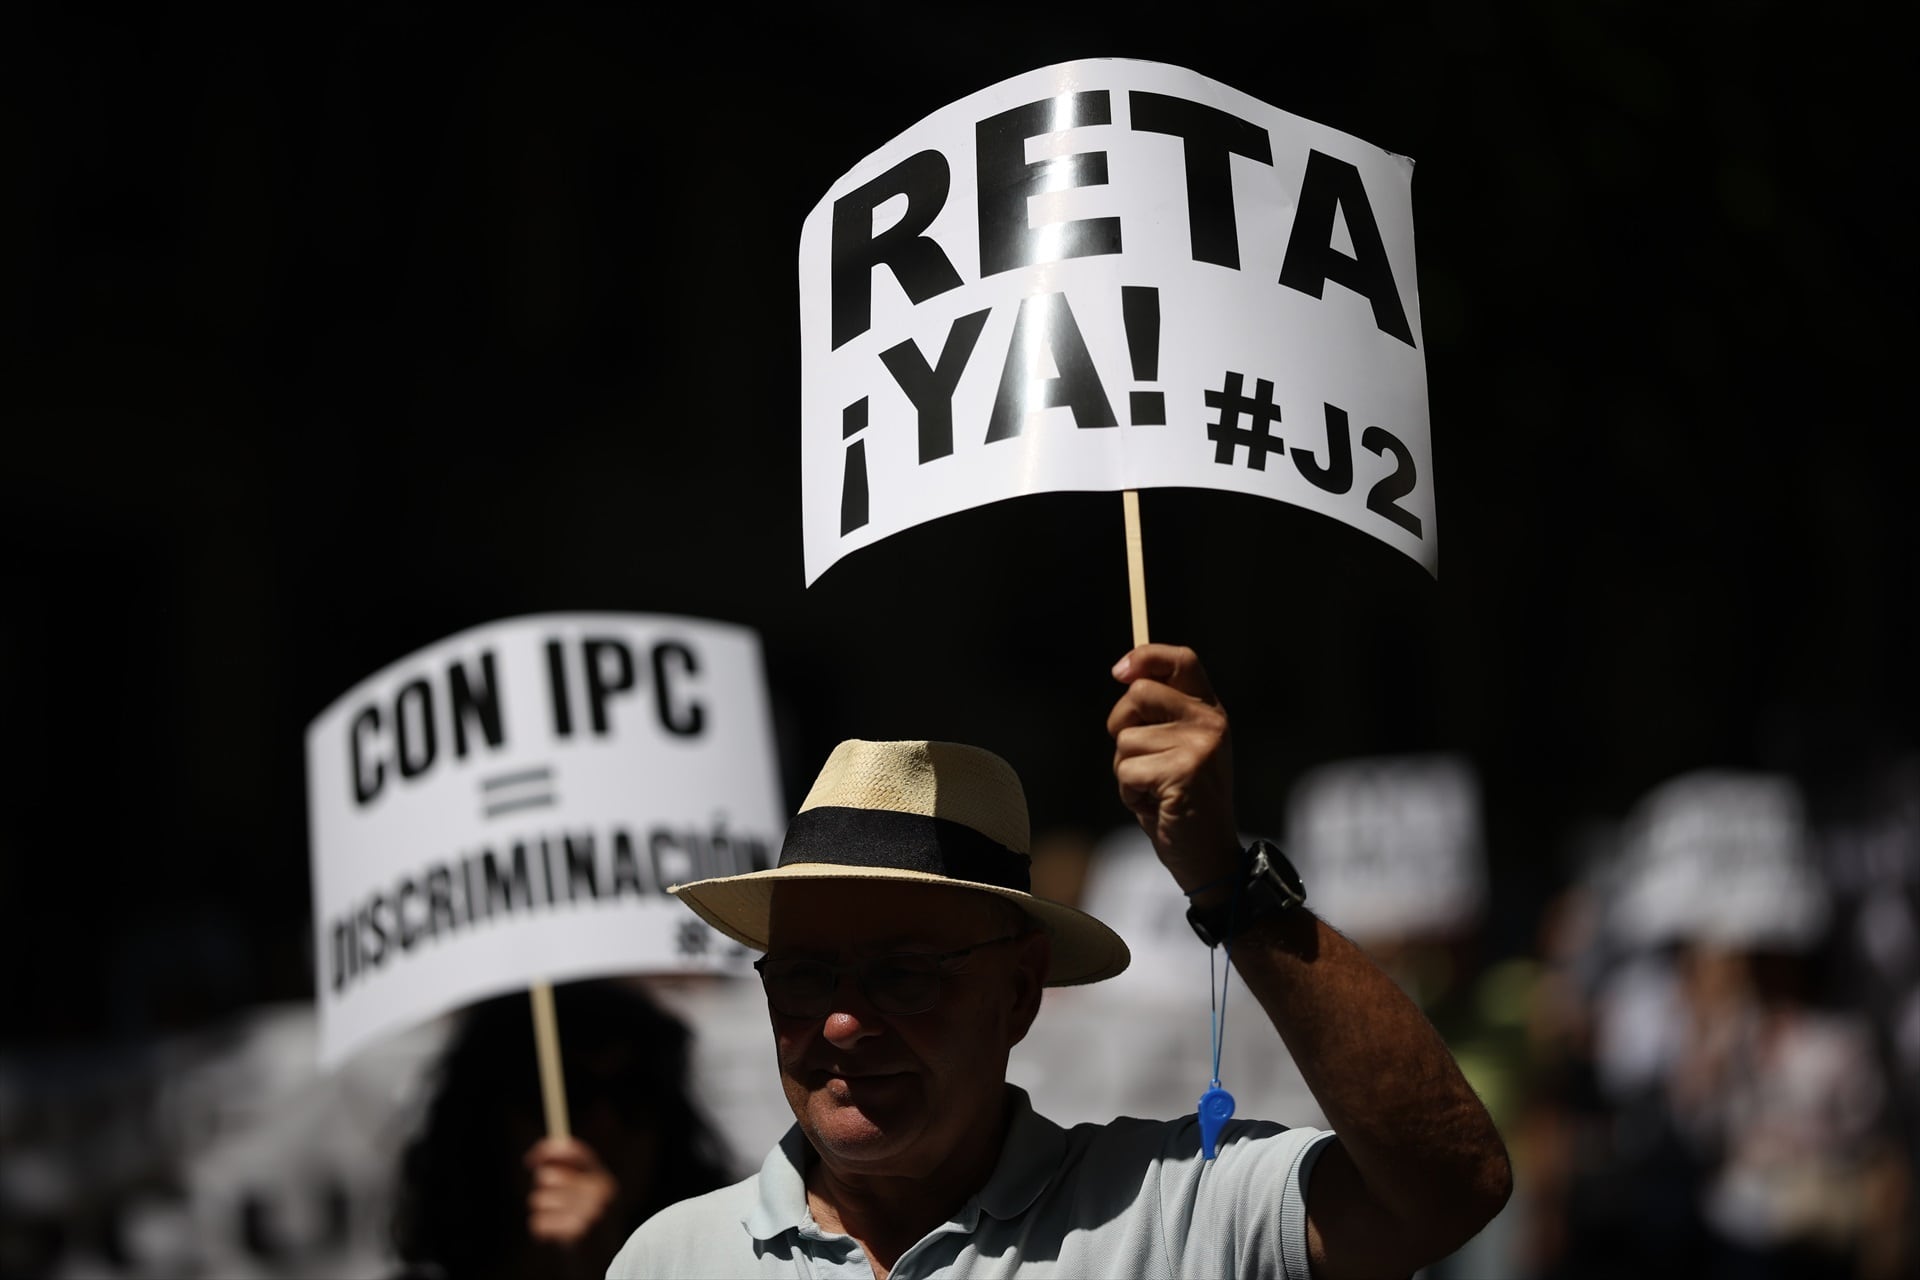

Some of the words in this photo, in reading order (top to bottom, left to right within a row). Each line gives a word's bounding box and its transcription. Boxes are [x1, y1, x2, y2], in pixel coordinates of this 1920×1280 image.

[832, 89, 1417, 352] RETA
[840, 285, 1166, 538] ¡YA!
[1204, 370, 1424, 541] #J2
[350, 649, 506, 807] CON
[544, 637, 706, 740] IPC
